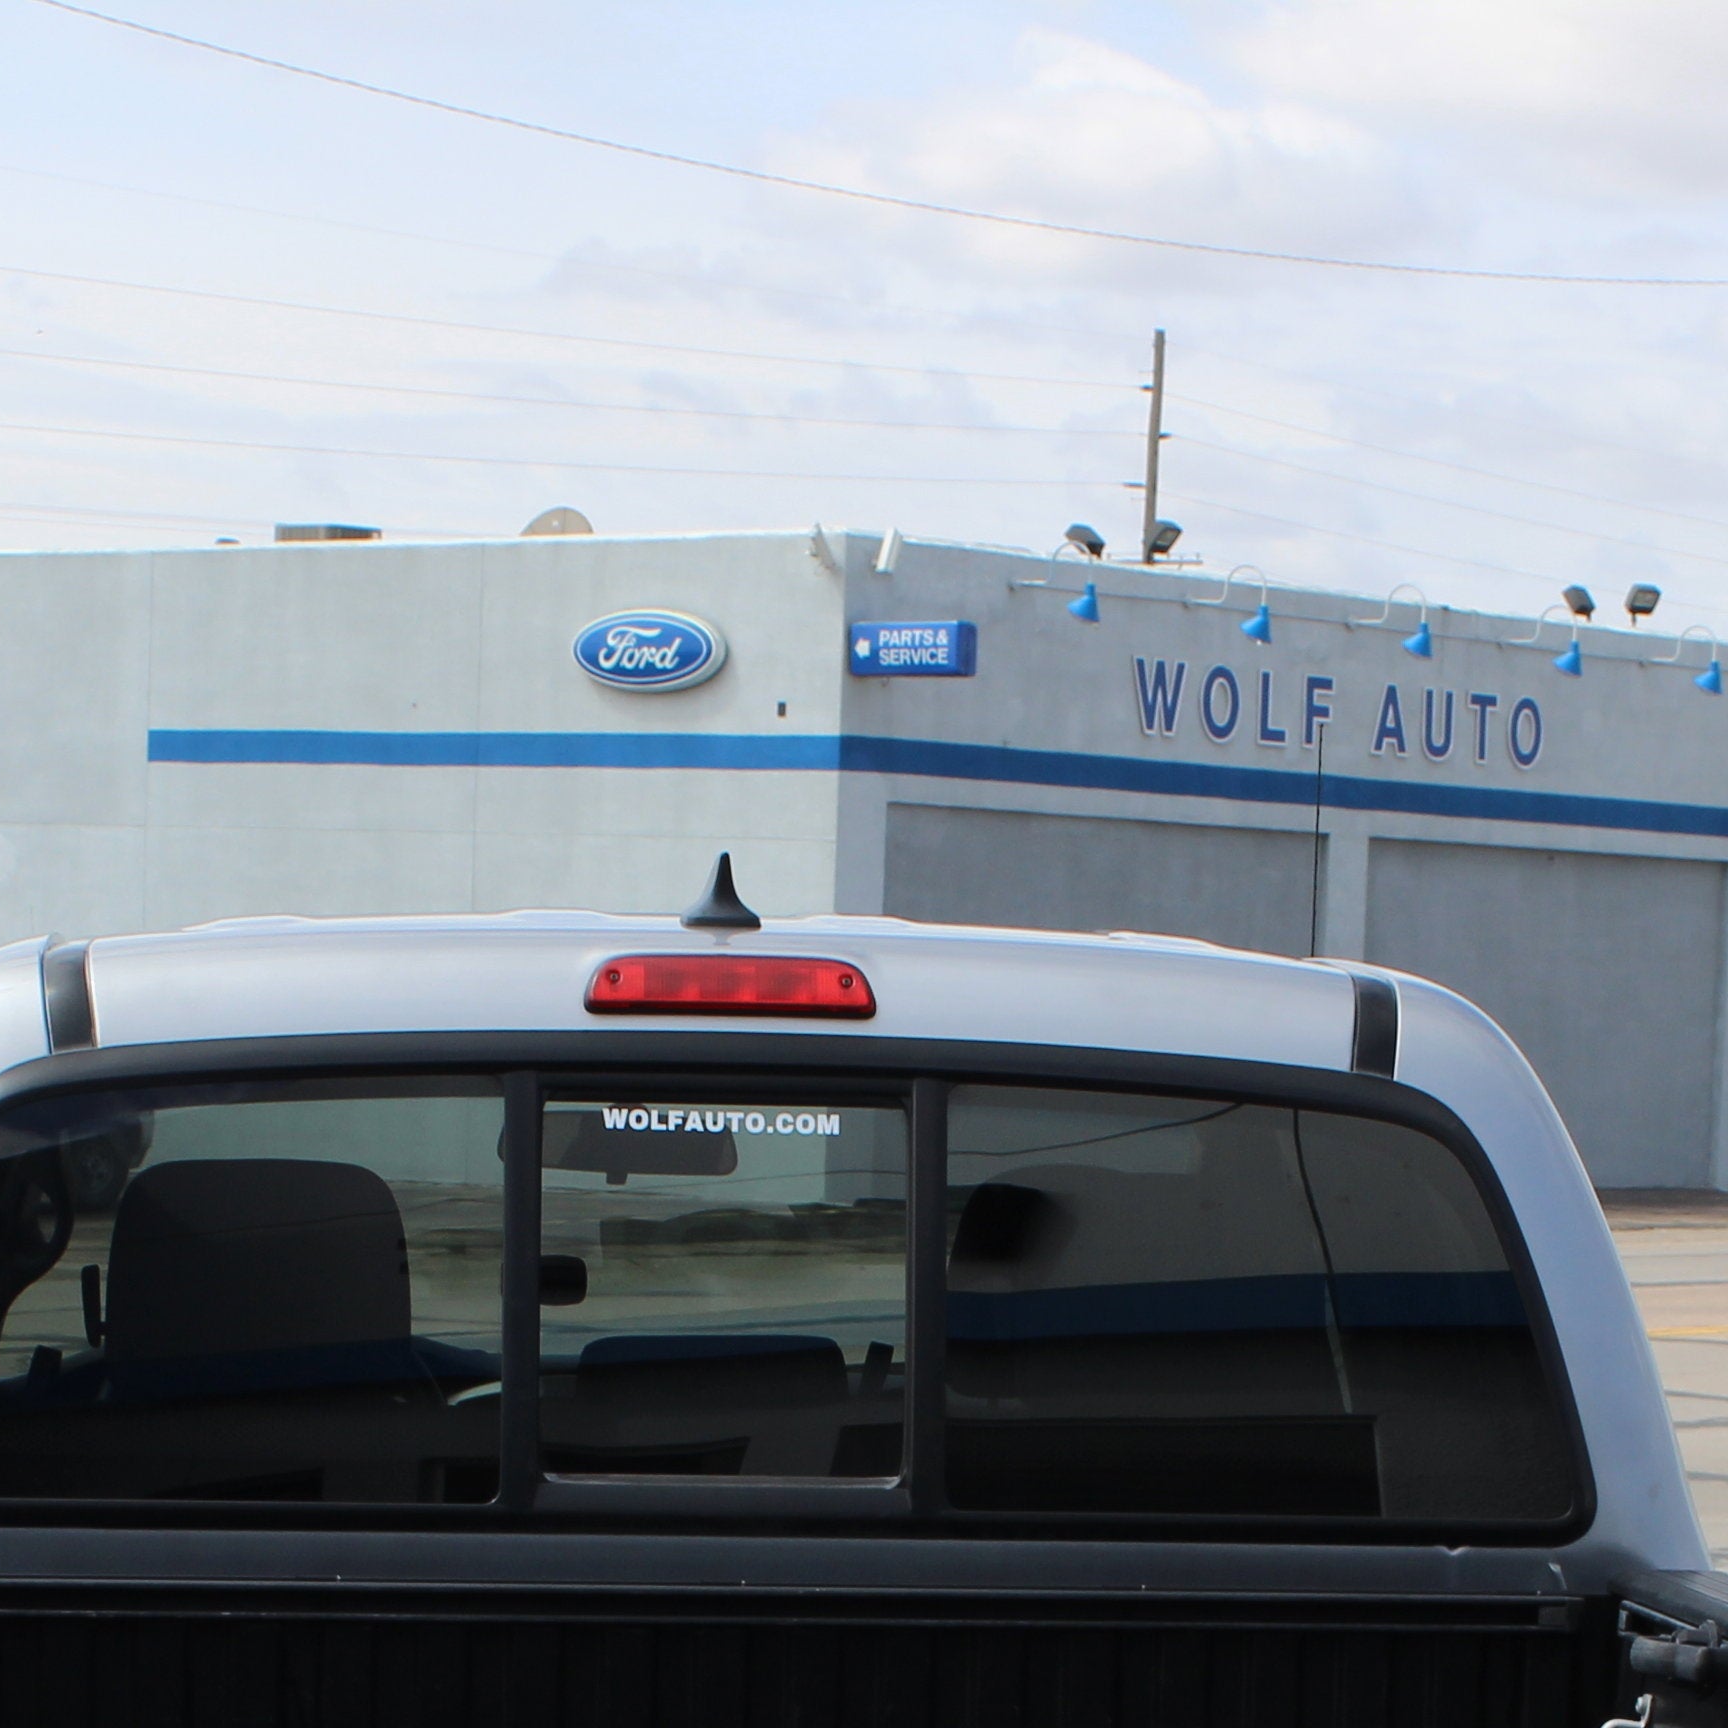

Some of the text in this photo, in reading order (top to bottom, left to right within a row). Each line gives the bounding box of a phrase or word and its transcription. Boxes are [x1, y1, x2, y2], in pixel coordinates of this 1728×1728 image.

[598, 625, 682, 670] Ford
[878, 628, 949, 647] PARTS &
[879, 647, 949, 666] SERVICE
[1134, 655, 1544, 770] WOLF AUTO
[602, 1107, 840, 1136] WOLFAUTO.COM
